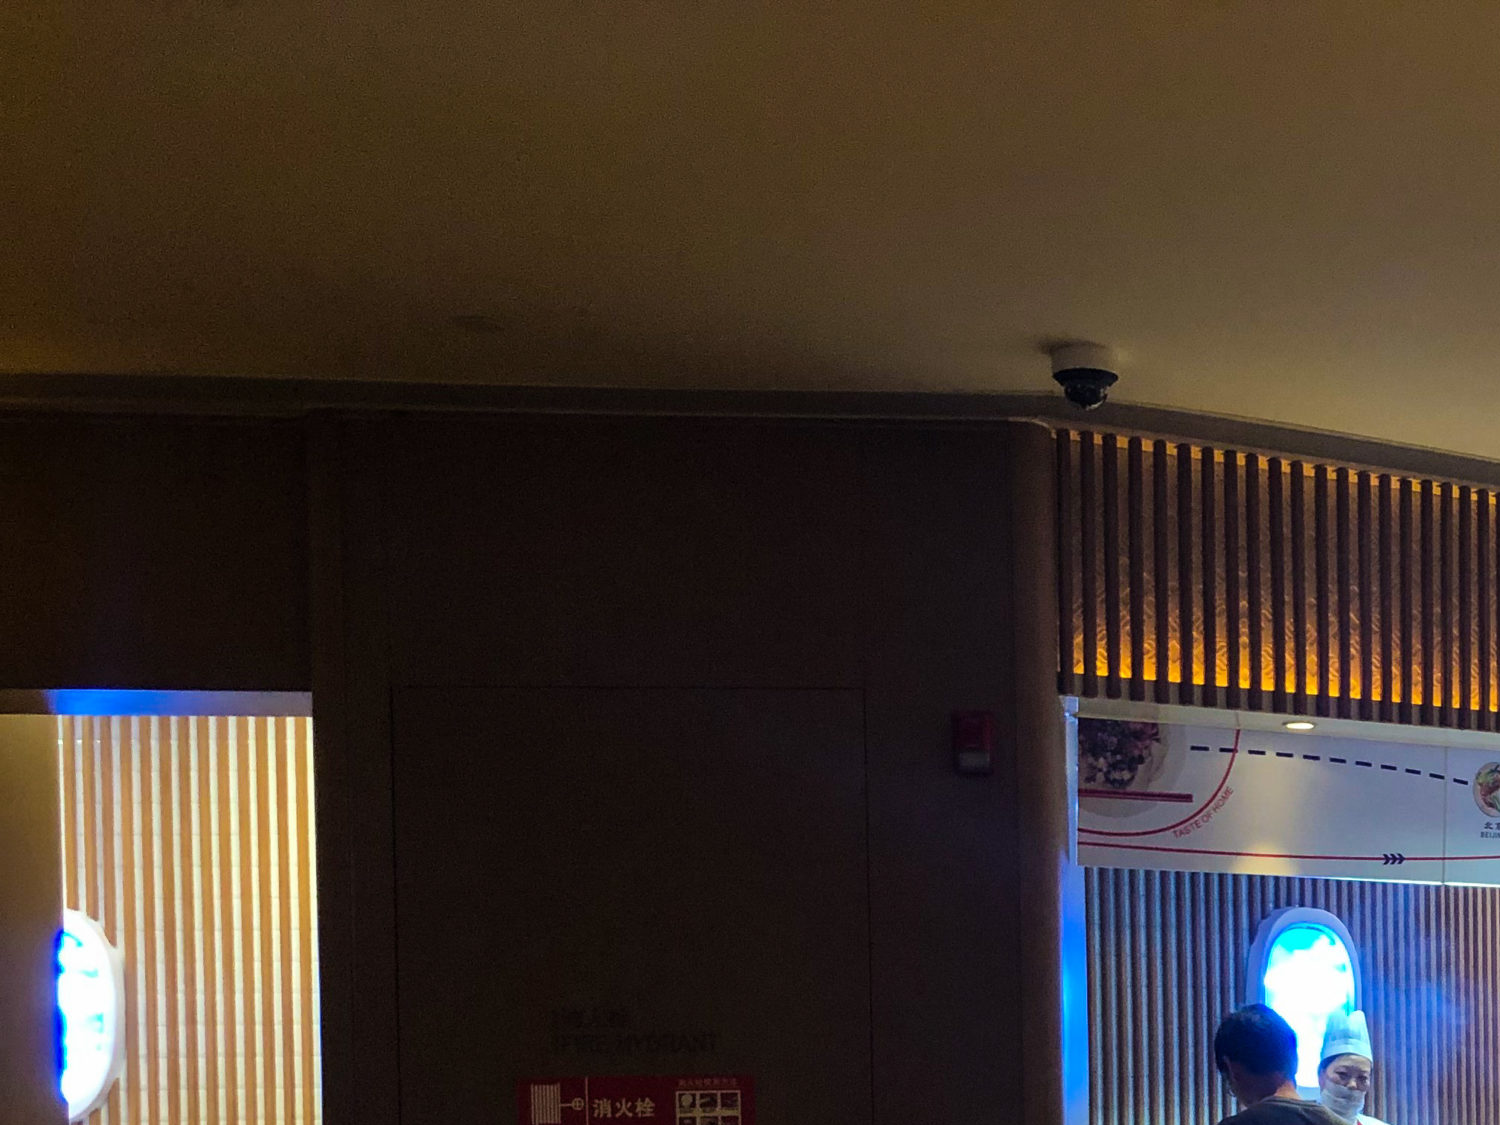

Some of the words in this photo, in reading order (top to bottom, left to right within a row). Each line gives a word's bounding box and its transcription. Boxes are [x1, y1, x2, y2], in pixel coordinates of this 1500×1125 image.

[1172, 819, 1202, 839] TASTE
[1201, 810, 1214, 824] OF
[592, 1096, 655, 1119] 消火栓
